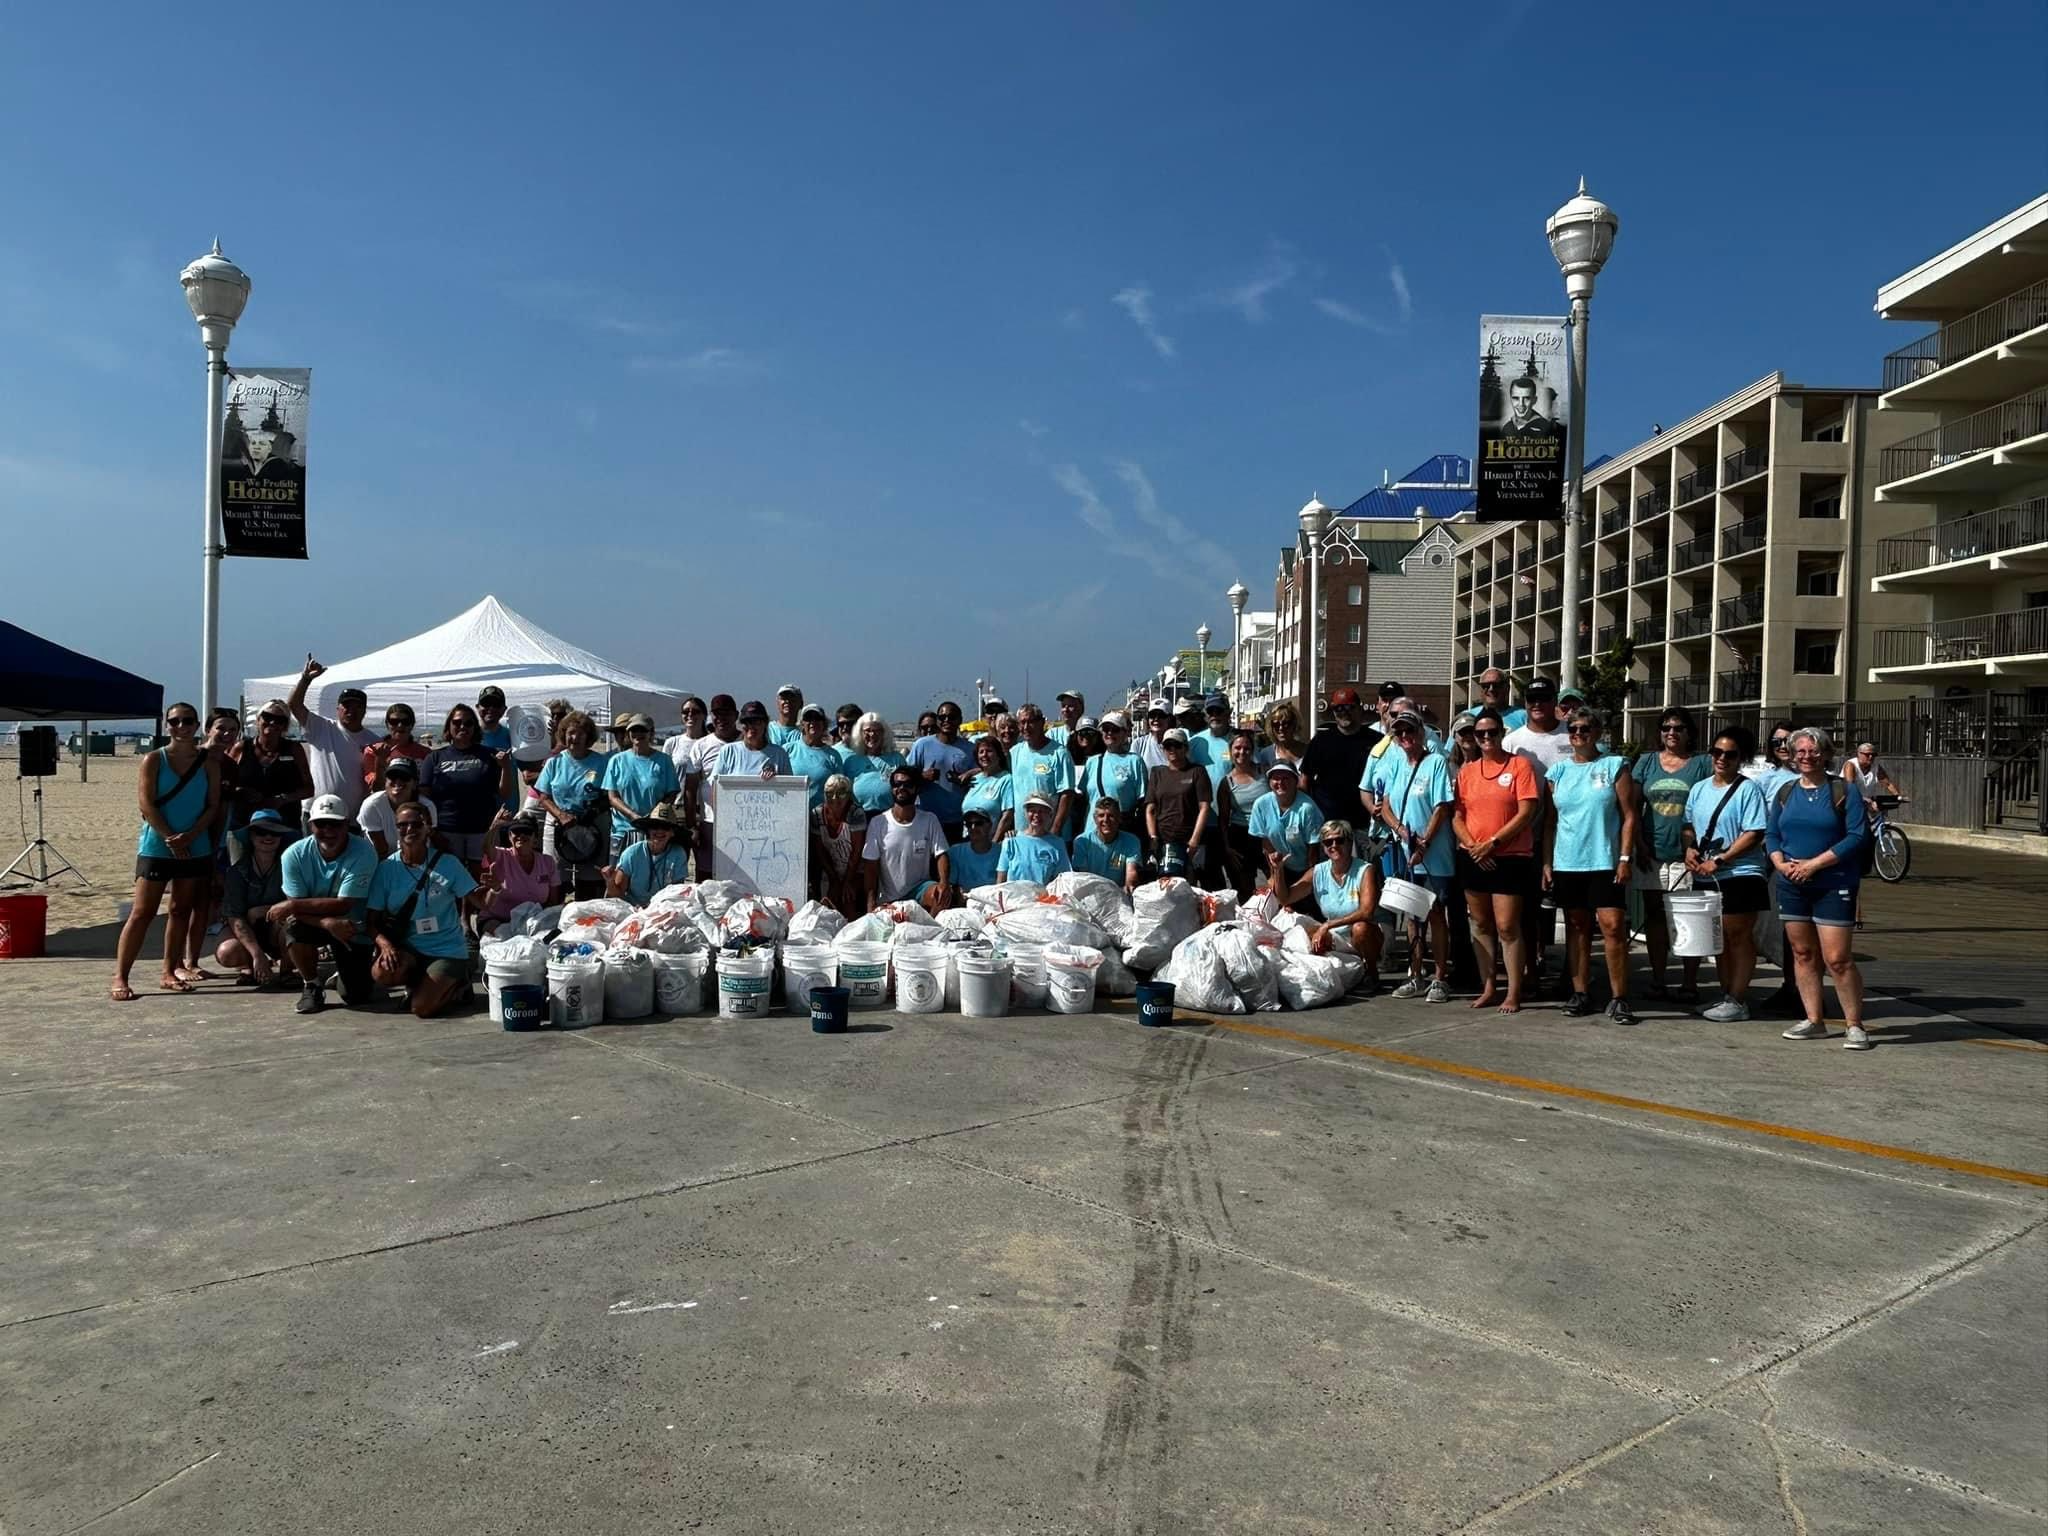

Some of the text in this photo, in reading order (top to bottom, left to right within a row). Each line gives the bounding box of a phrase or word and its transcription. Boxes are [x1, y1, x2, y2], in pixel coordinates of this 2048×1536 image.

[1489, 331, 1564, 350] Ocean City
[235, 383, 273, 396] Ocean
[1506, 435, 1559, 448] We Proudly
[1485, 439, 1558, 460] Honor
[227, 480, 297, 501] Honor
[246, 478, 299, 491] We Proudly
[734, 791, 782, 805] CURRENT
[740, 806, 772, 819] TRASH
[736, 819, 779, 832] WEIGHT
[724, 836, 790, 884] 275
[504, 1007, 539, 1020] Corona
